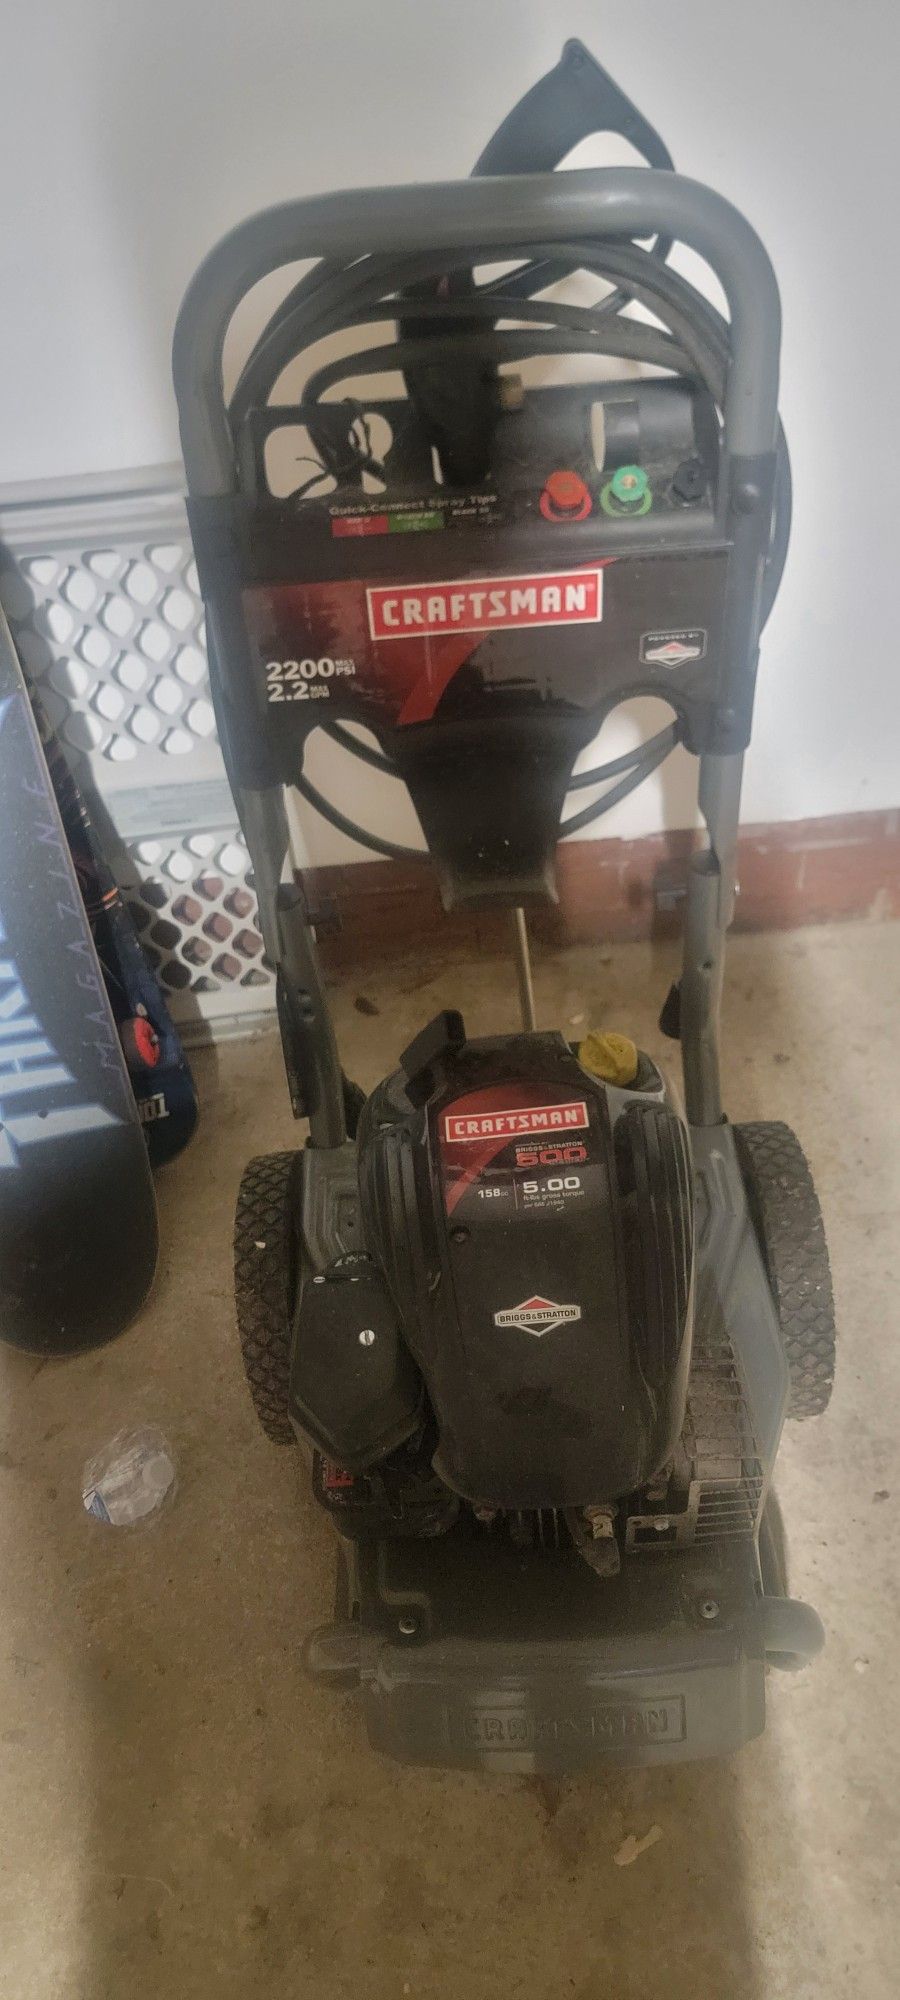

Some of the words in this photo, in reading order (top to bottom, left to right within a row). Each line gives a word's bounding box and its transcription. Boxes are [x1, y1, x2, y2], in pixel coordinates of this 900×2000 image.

[382, 583, 586, 627] CRAFTSMAN
[265, 657, 335, 681] 2200
[336, 666, 355, 675] PSI
[267, 681, 310, 702] 2.2
[23, 776, 122, 1074] MAGAZINE
[454, 1109, 578, 1135] CRAFTSMAN
[516, 1147, 587, 1167] 500
[478, 1188, 501, 1198] 158
[523, 1177, 580, 1194] 5.00
[562, 1190, 585, 1198] torque
[464, 1709, 668, 1741] CRAMAN
